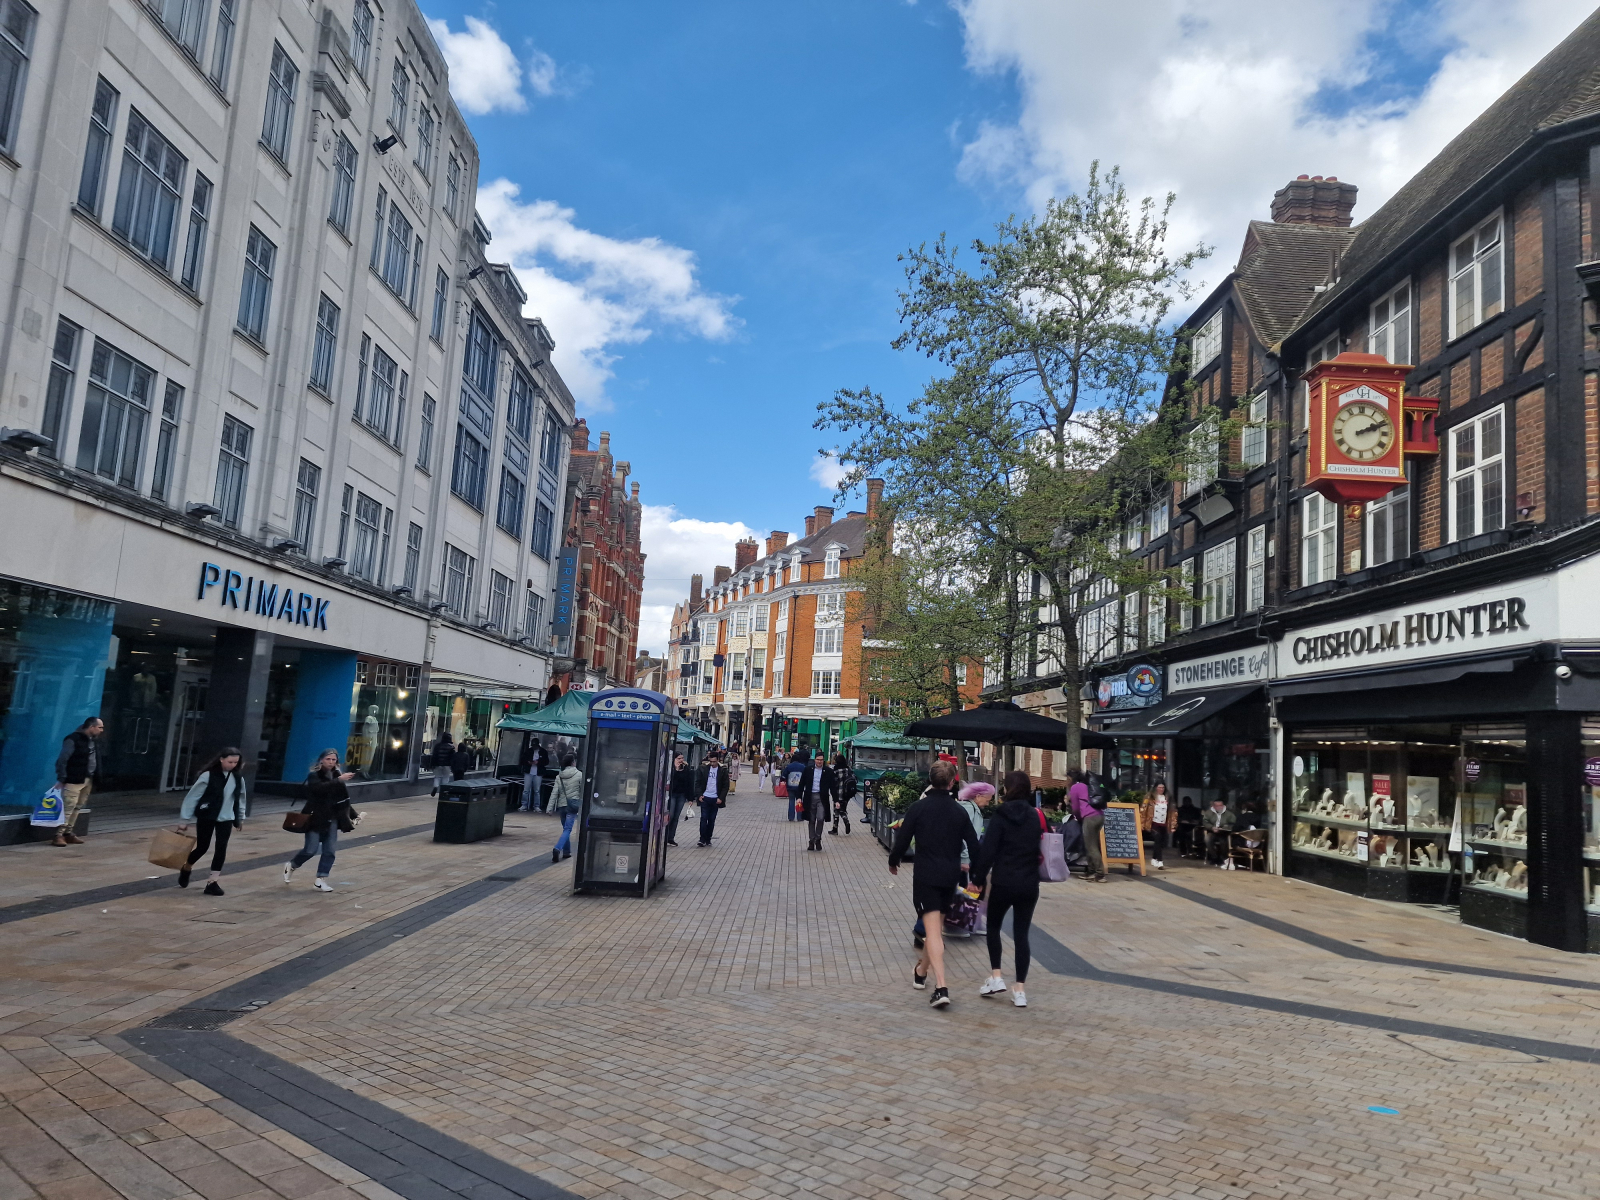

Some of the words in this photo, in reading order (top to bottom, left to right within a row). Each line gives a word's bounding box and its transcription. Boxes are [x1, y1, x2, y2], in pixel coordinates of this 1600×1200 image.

[1329, 465, 1366, 474] CHISHOLM
[1367, 466, 1397, 475] HUNTER
[197, 561, 331, 631] PRIMARK
[557, 556, 573, 624] PRIMARK
[1293, 620, 1400, 665] CHISHOLM
[1403, 597, 1530, 647] HUNTER
[1175, 655, 1246, 685] STONEHENGE
[1111, 680, 1128, 697] FRIED
[636, 714, 653, 722] phone
[1374, 781, 1389, 789] SALE
